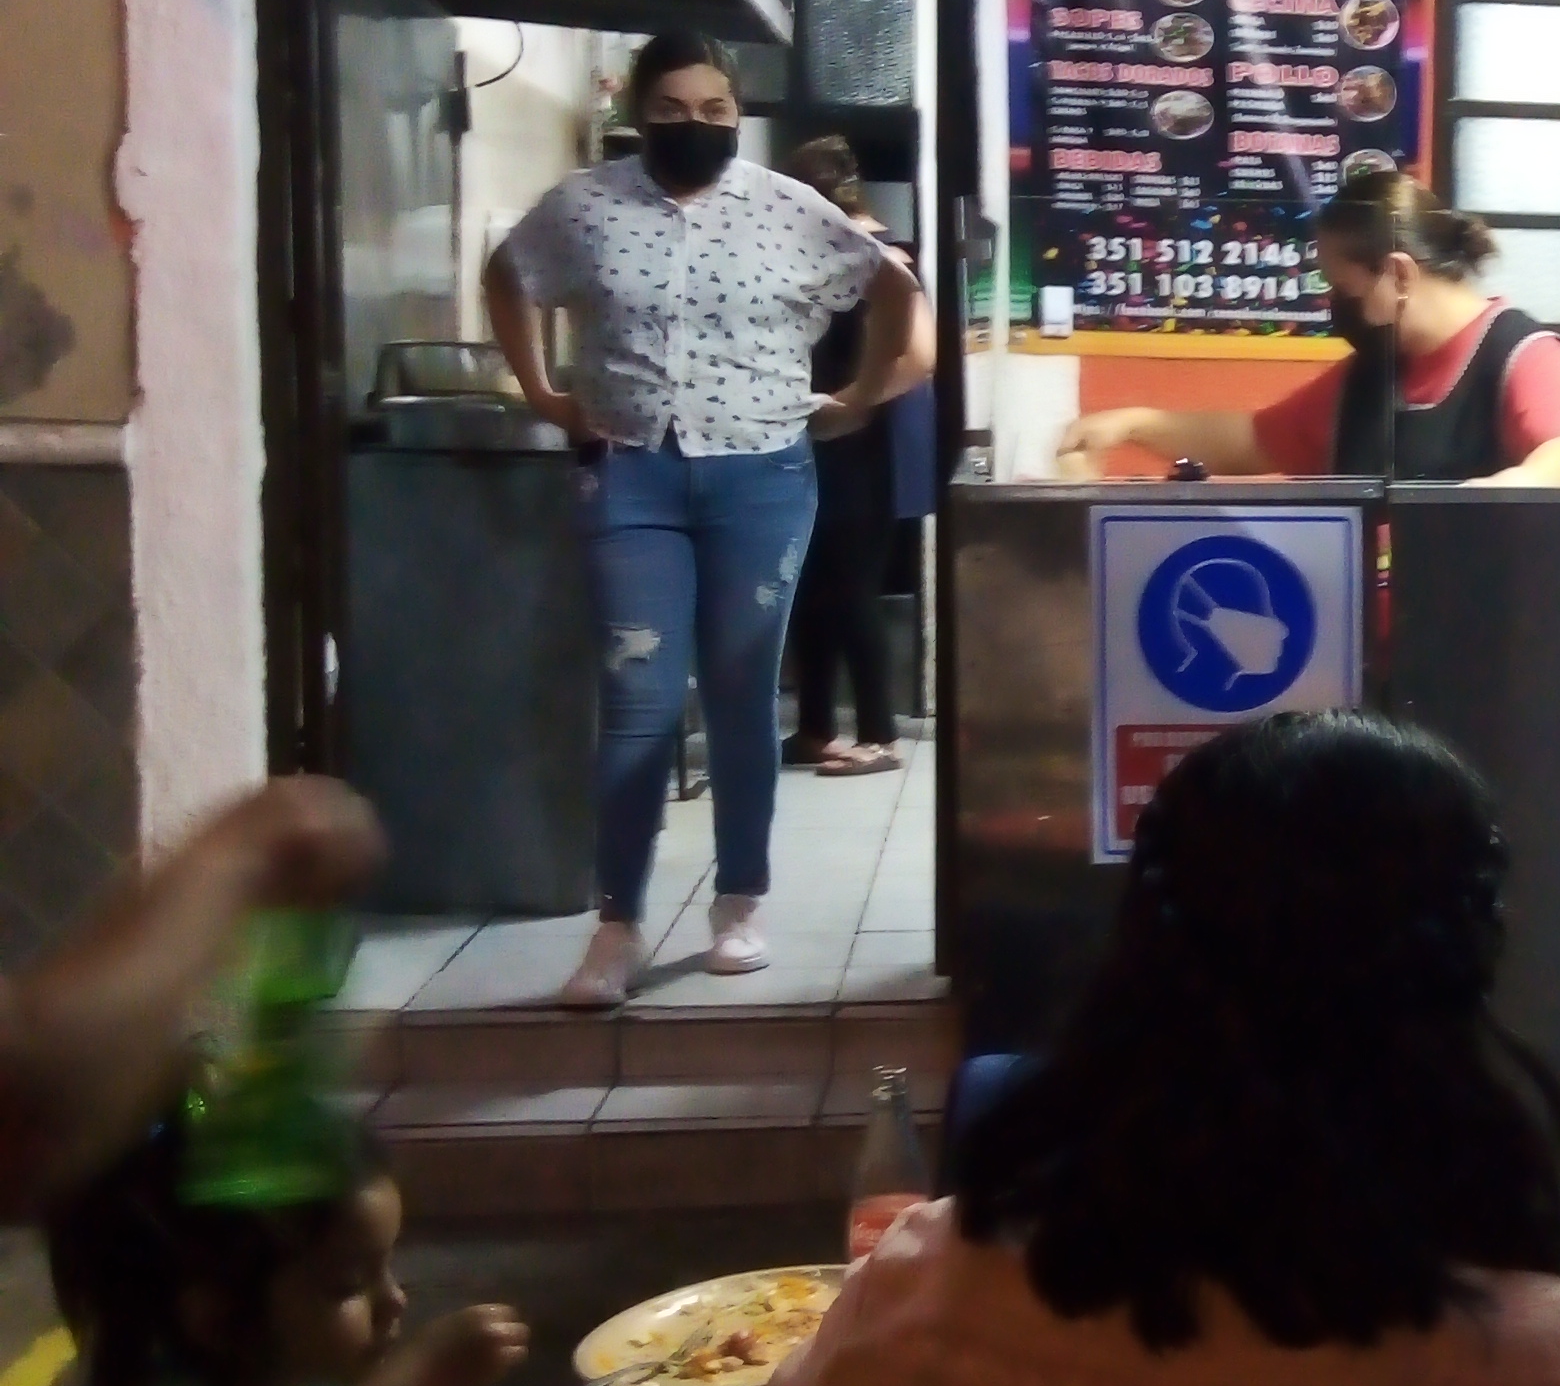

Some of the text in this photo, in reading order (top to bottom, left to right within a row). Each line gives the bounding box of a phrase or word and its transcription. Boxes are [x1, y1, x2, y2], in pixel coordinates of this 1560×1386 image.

[1050, 7, 1144, 31] SOPES
[1048, 60, 1214, 87] TACOS DORADOS
[1226, 61, 1340, 88] POLLO
[1050, 148, 1162, 172] BEBIDAS
[1086, 236, 1301, 267] 351 512 2146
[1087, 271, 1300, 301] 351 103 8914
